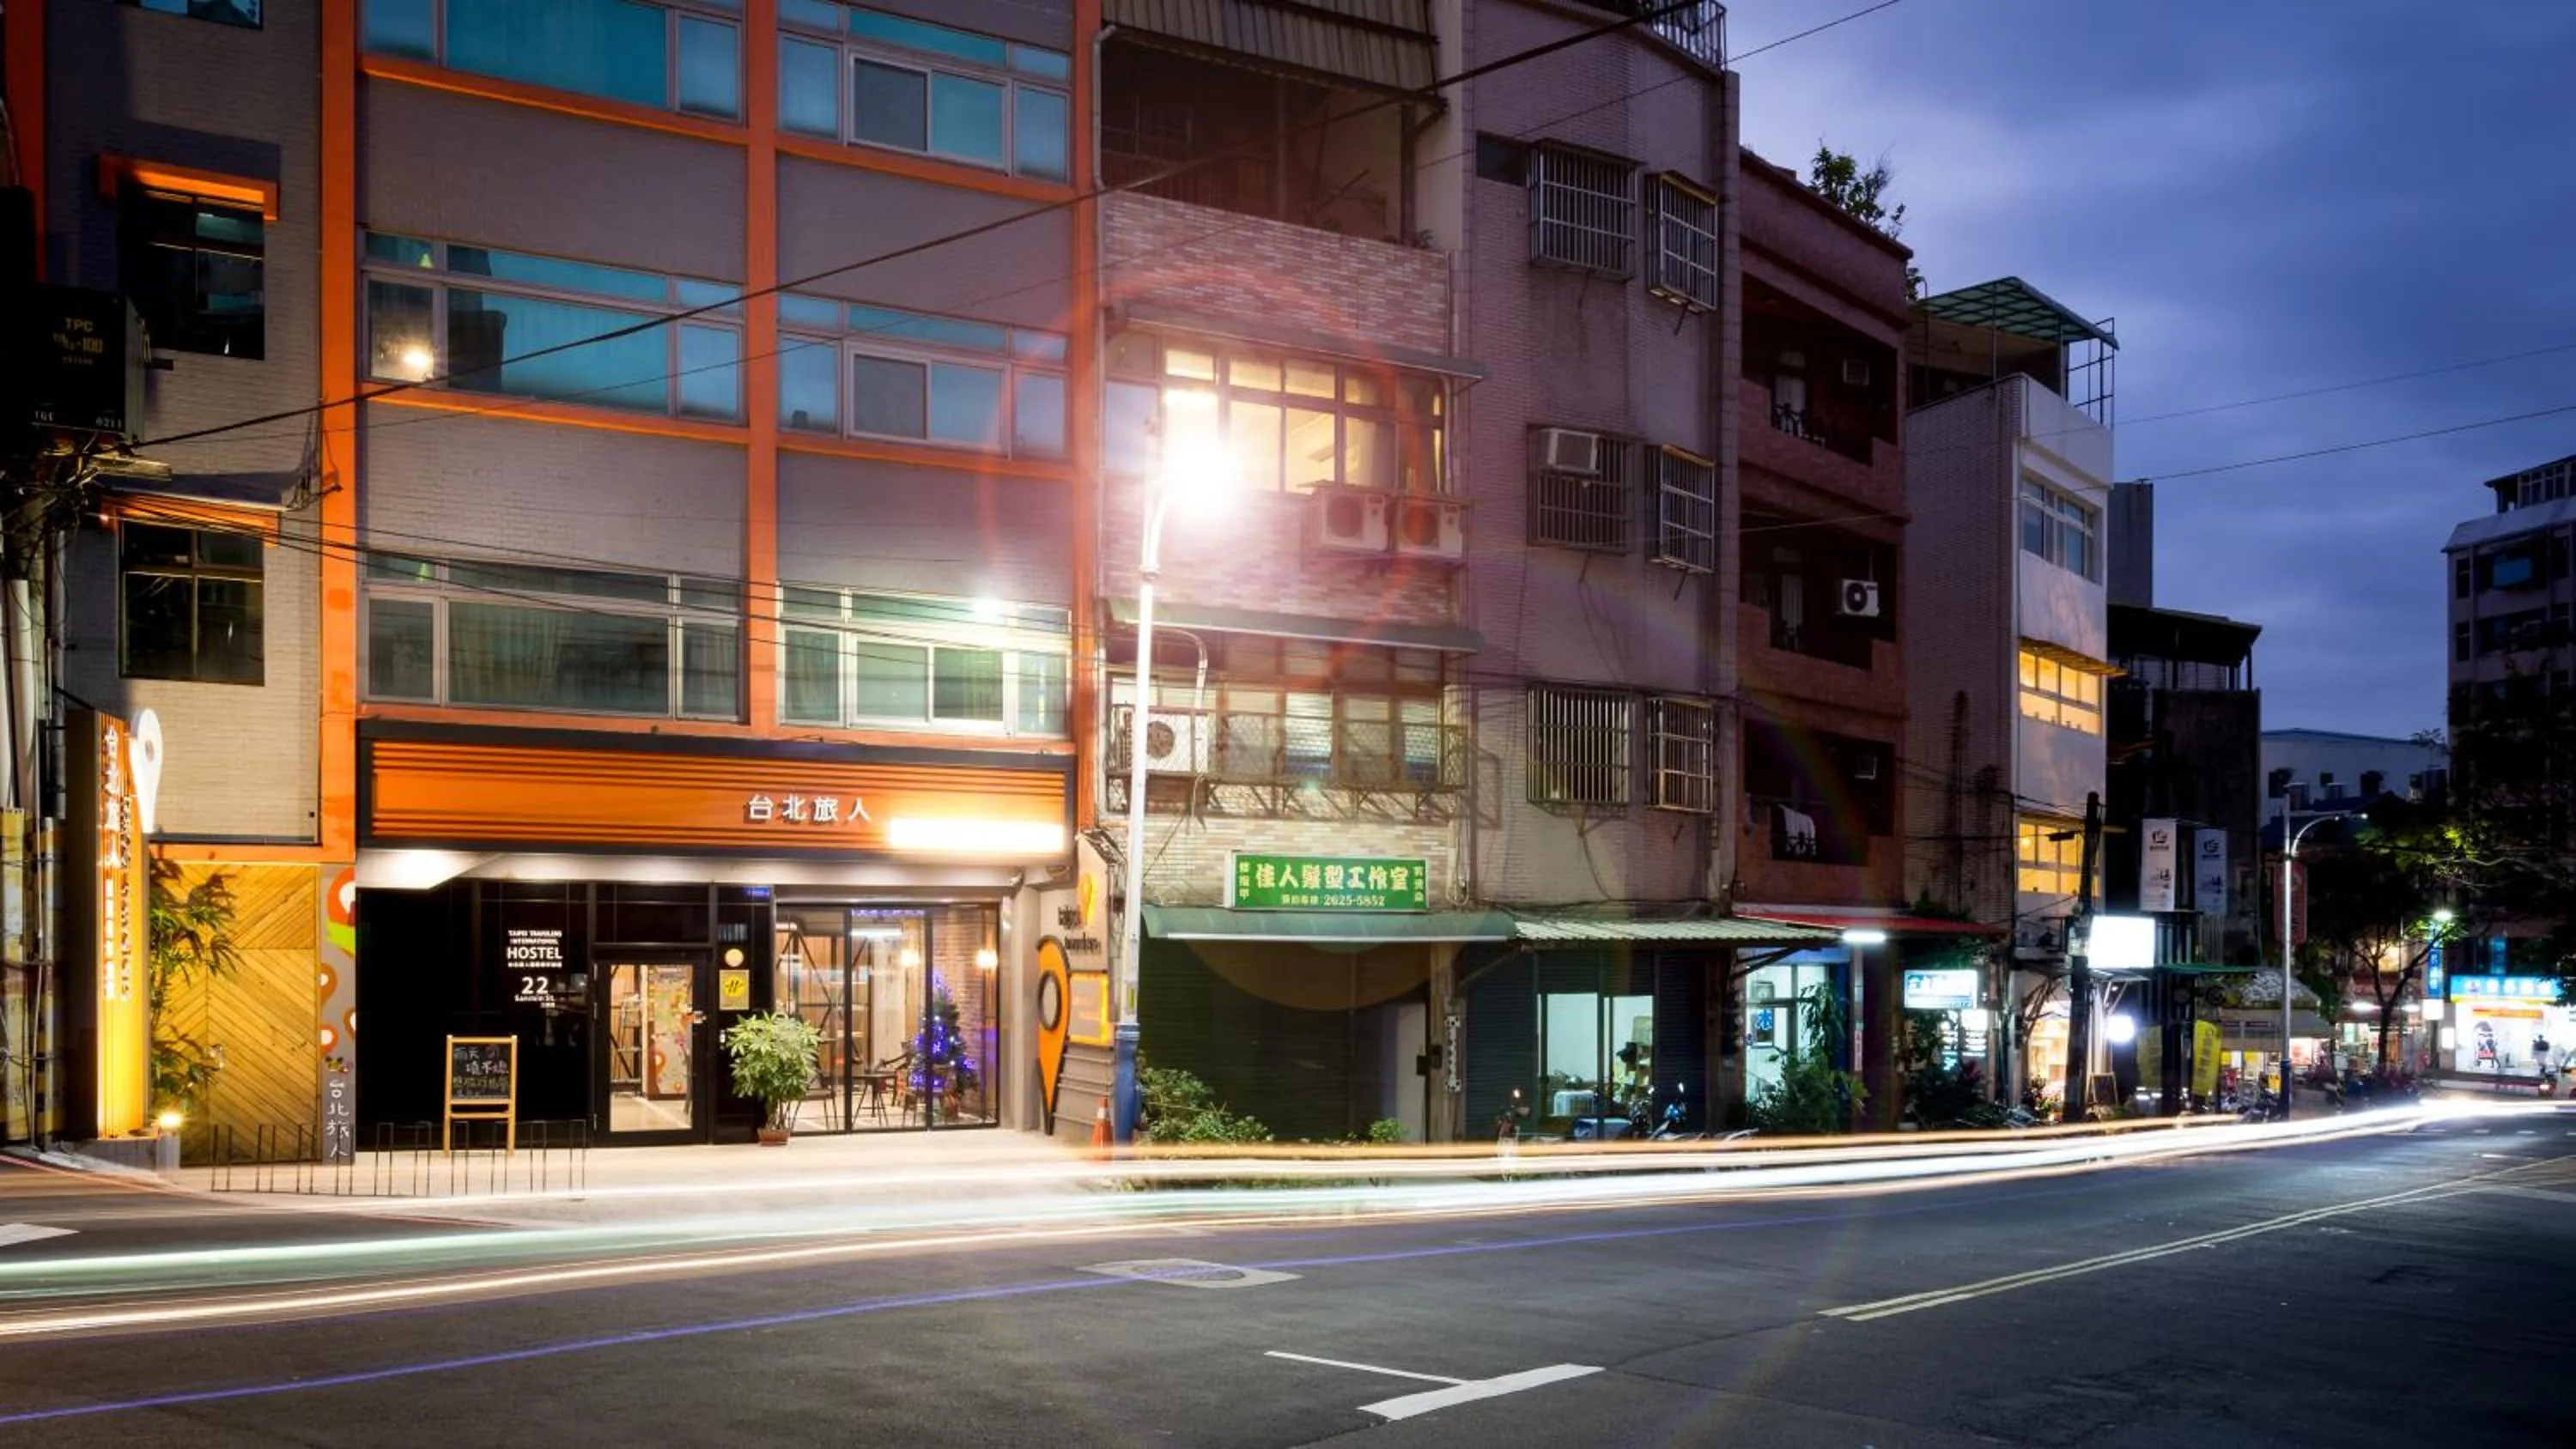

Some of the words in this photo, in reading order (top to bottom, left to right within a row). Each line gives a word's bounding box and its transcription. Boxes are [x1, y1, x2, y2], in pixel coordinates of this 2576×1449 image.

[65, 318, 94, 332] TPC
[749, 794, 872, 822] 台北旅人
[507, 947, 563, 960] HOSTEL
[521, 977, 549, 994] 22
[326, 1080, 349, 1158] 台北旅人
